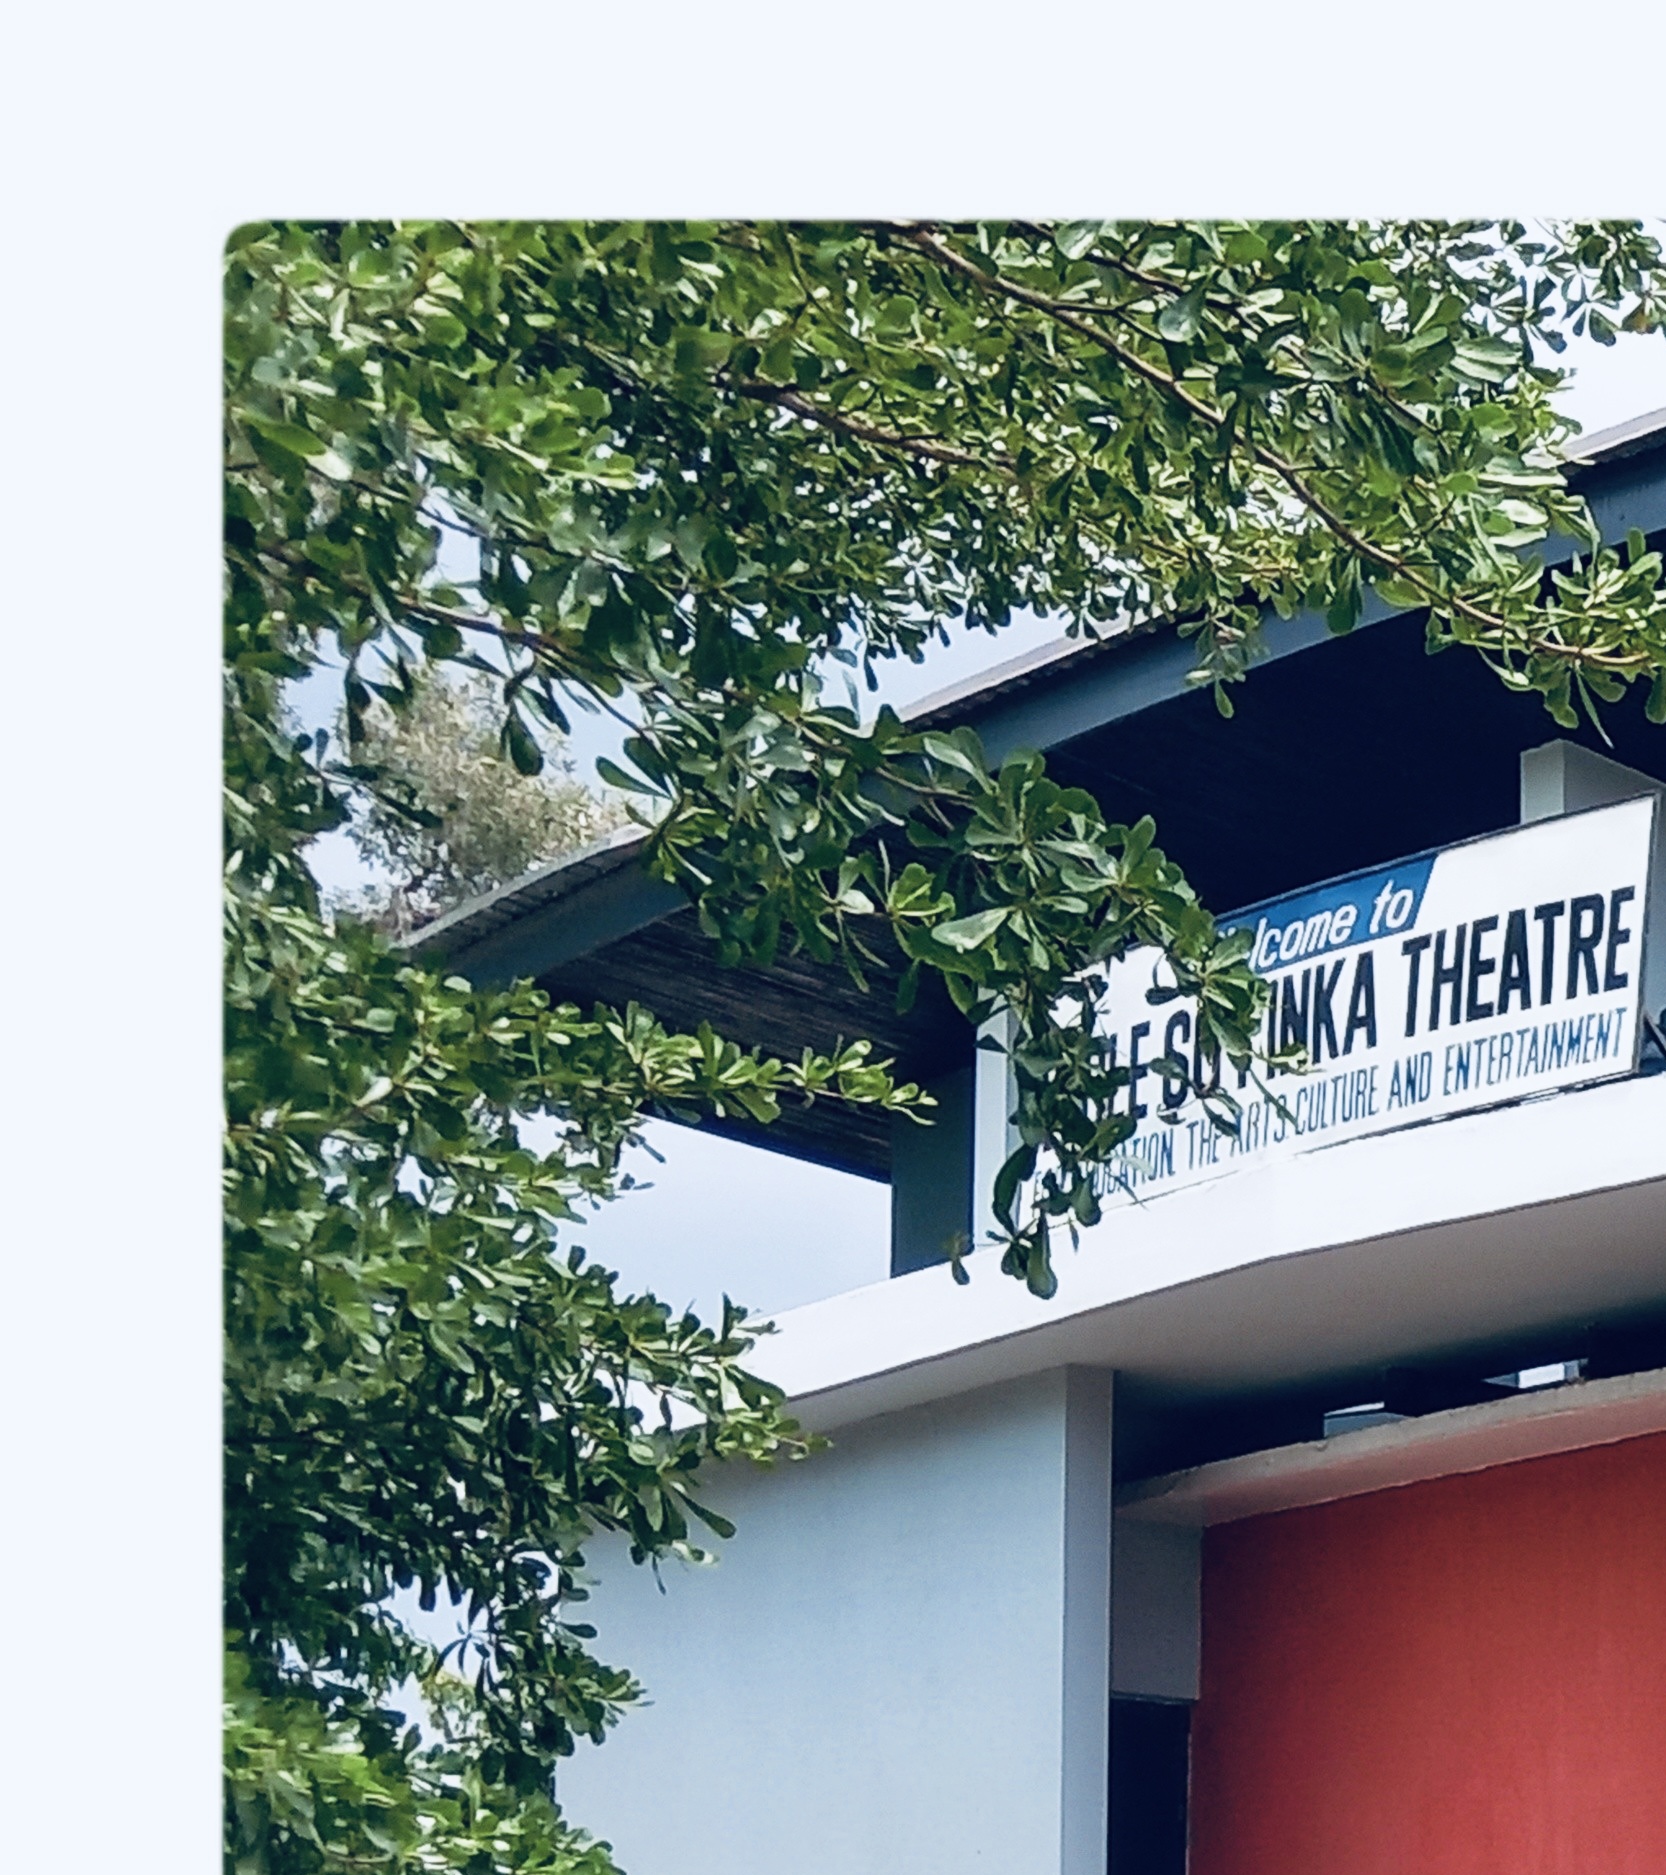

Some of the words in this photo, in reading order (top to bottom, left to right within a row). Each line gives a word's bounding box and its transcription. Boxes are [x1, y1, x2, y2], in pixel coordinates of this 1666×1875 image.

[1216, 904, 1357, 969] lcome
[1369, 879, 1413, 934] to
[1162, 950, 1376, 1109] SOINKA
[1401, 885, 1635, 1037] THEATRE
[1296, 1065, 1379, 1135] CULTURE
[1387, 1052, 1432, 1111] AND
[1443, 1007, 1628, 1096] ENTERTAINMENT
